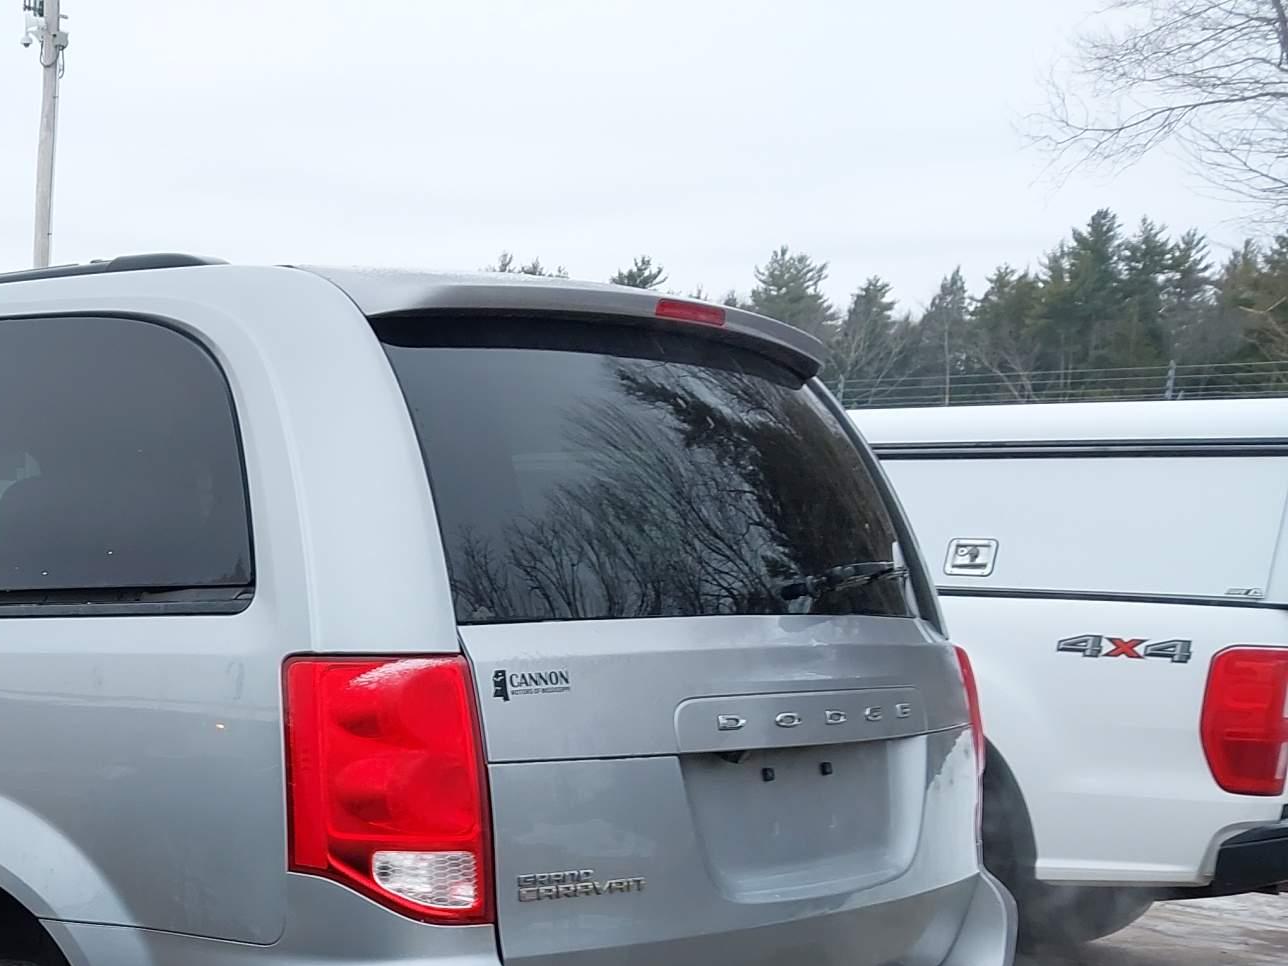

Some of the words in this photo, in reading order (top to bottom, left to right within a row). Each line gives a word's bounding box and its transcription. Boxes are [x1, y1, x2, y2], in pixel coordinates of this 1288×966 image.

[509, 671, 570, 688] CANNON
[717, 703, 912, 731] DODGE
[518, 869, 594, 887] GRAND
